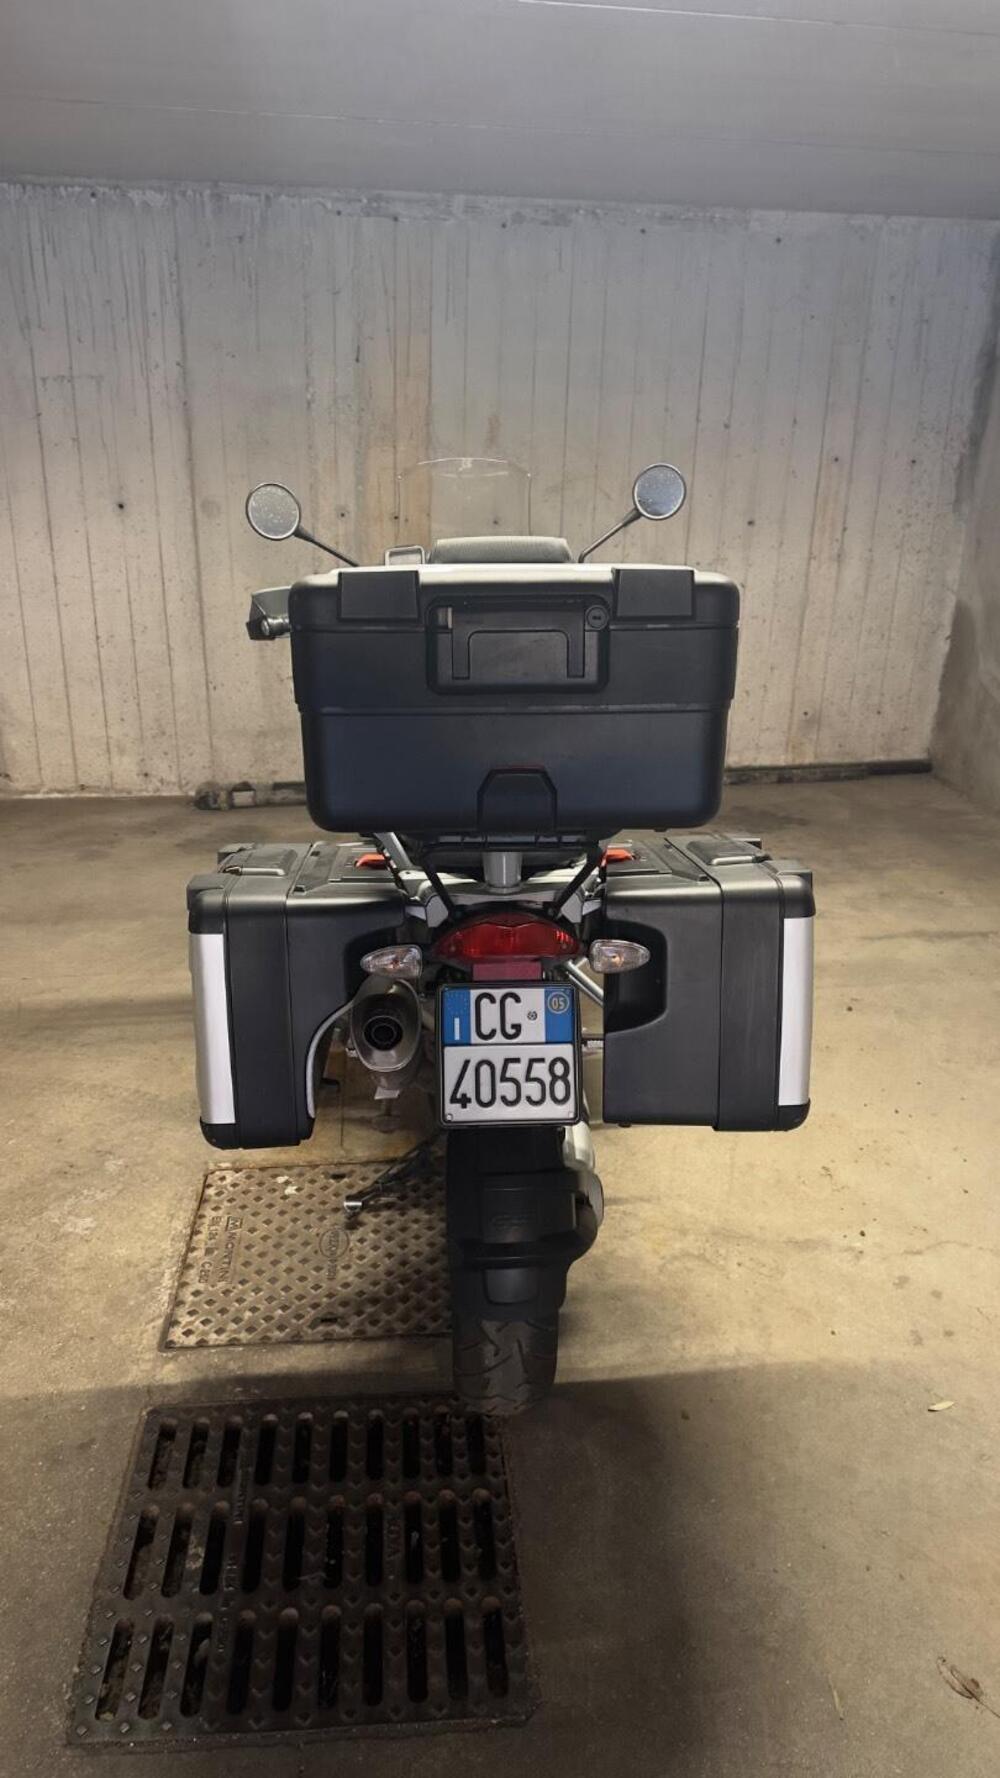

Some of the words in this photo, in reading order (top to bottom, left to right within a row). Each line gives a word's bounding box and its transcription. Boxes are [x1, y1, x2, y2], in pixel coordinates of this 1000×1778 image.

[475, 992, 522, 1041] CG
[551, 997, 565, 1009] 05
[450, 1056, 571, 1109] 40558
